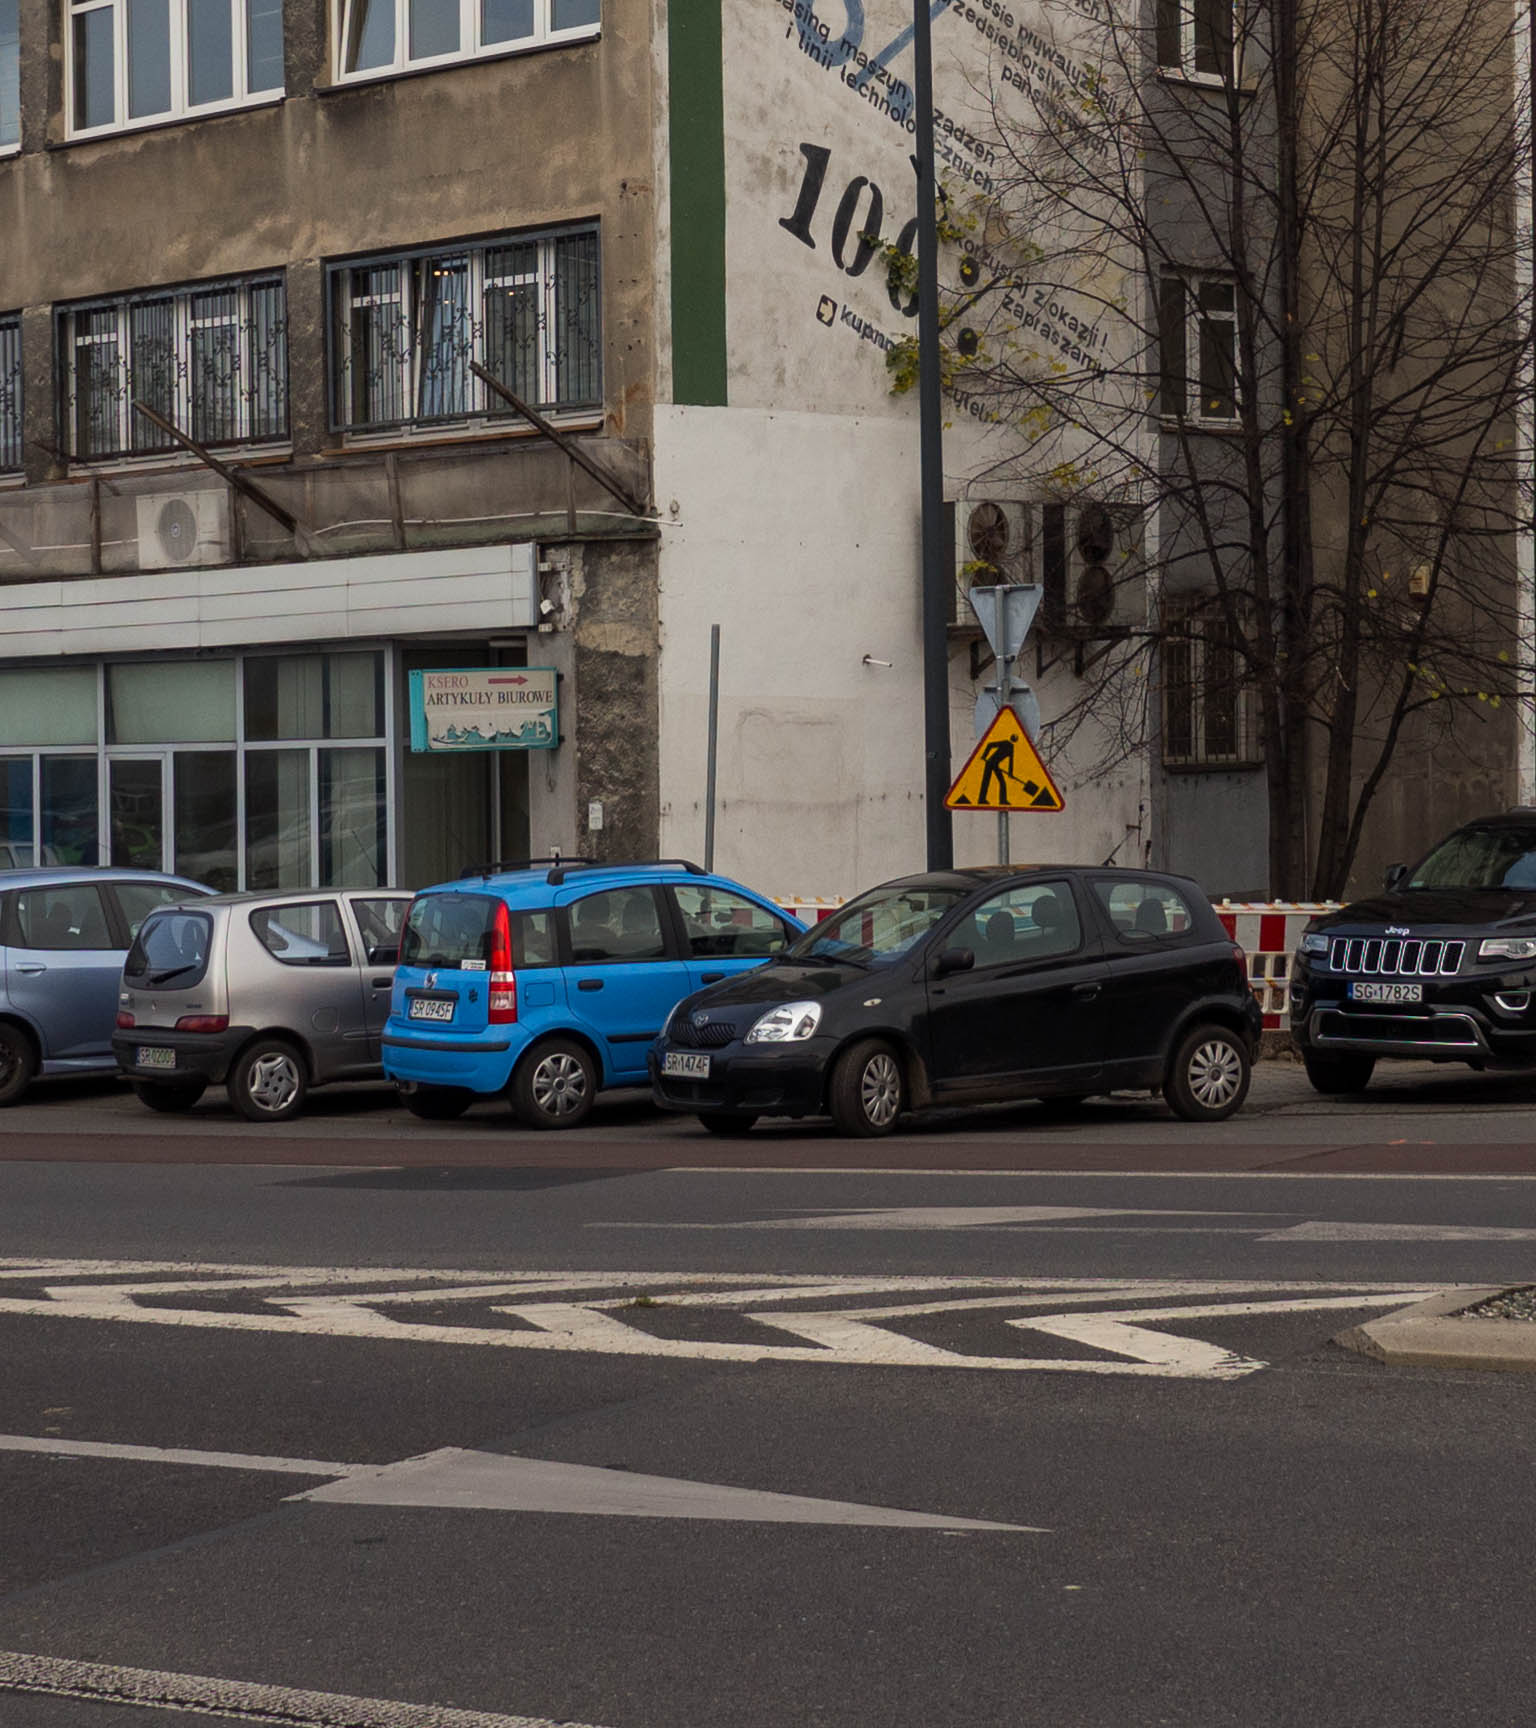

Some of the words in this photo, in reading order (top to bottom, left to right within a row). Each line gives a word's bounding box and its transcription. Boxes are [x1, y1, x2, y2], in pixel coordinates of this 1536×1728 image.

[798, 30, 834, 72] linii
[1001, 294, 1108, 383] zapraszamy
[427, 674, 469, 689] KSERO
[426, 691, 494, 706] ARTYKUŁY
[497, 690, 553, 705] BIUROWE
[1384, 925, 1410, 936] Jeep
[1354, 984, 1374, 999] SG
